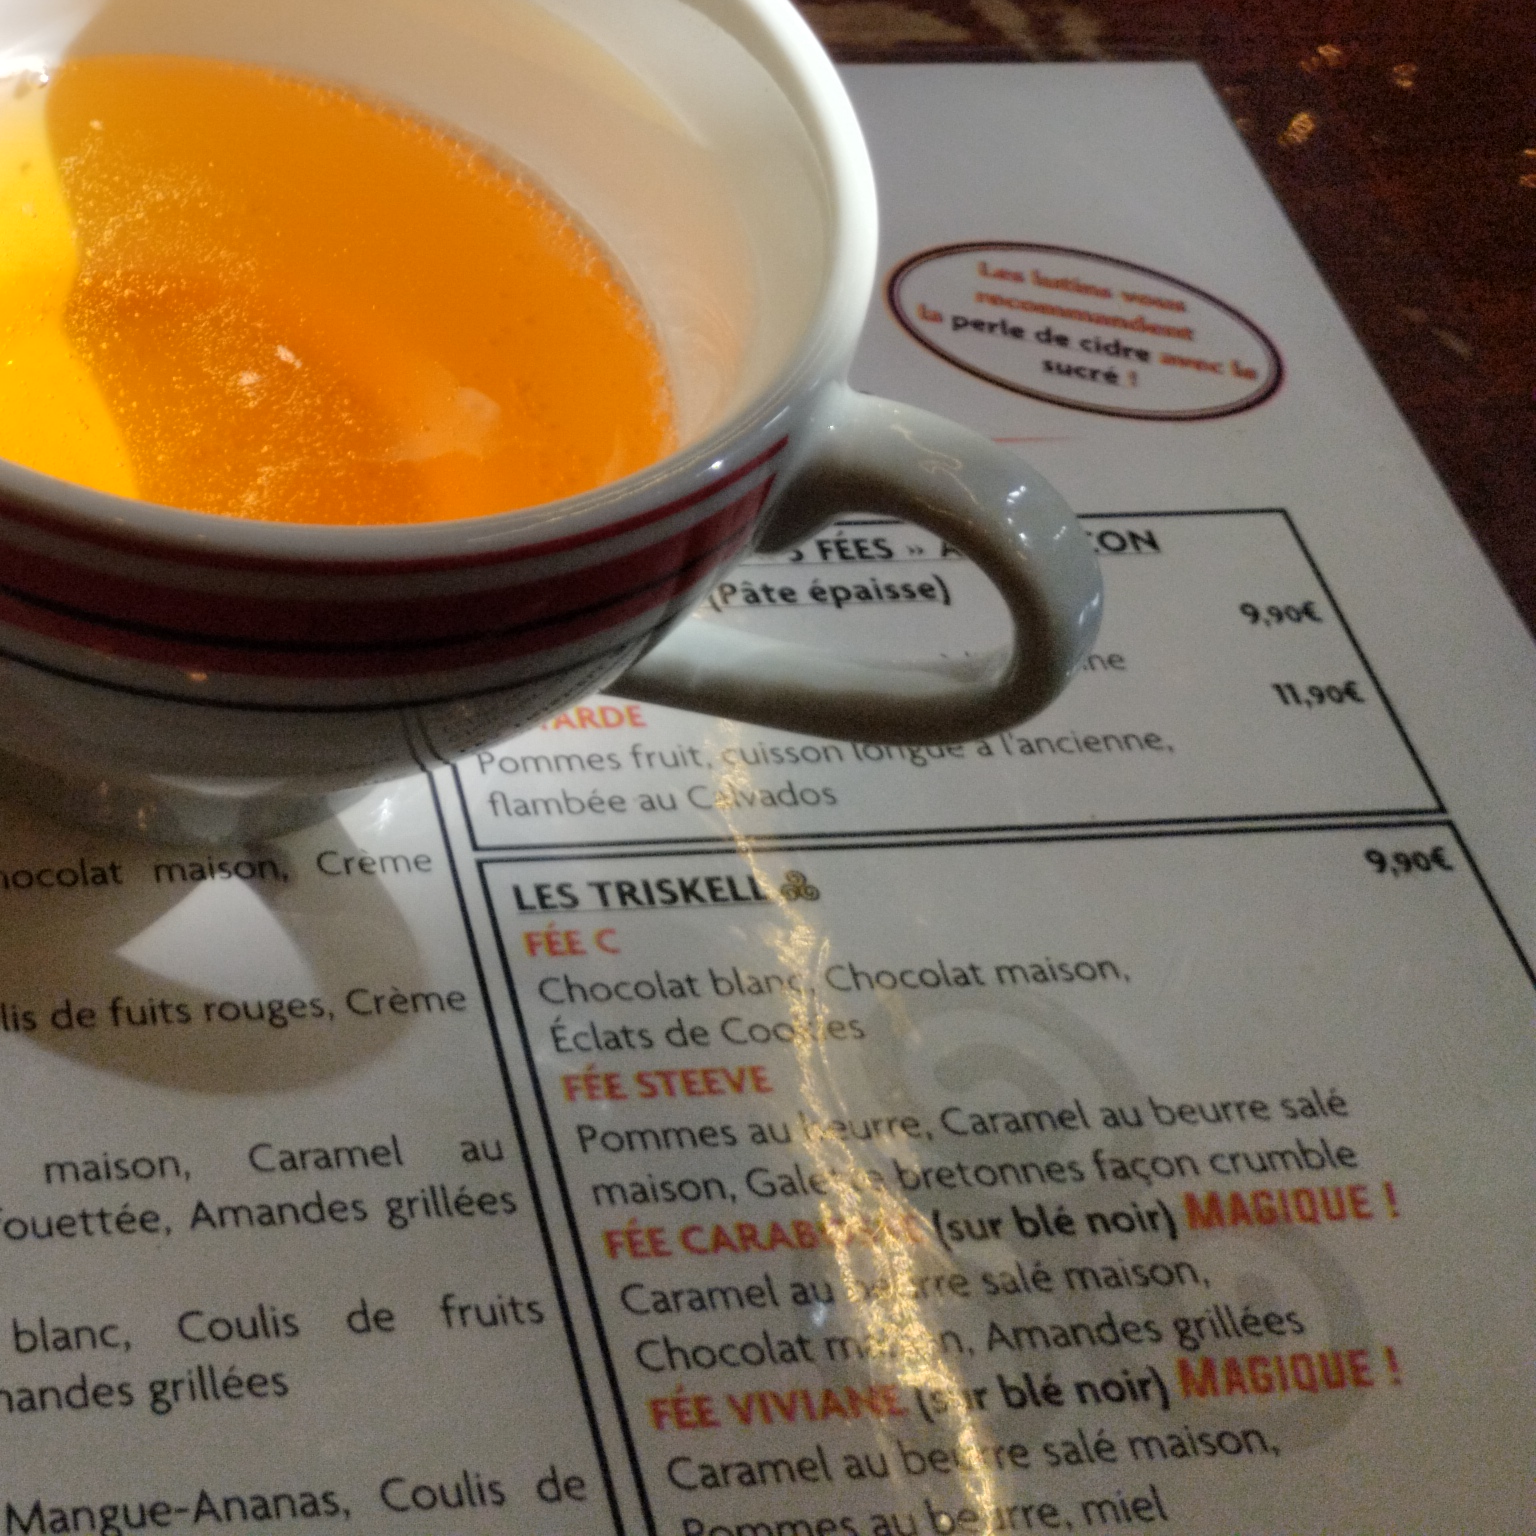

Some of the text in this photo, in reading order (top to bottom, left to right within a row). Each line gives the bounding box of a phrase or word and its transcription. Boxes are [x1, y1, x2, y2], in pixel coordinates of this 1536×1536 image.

[977, 261, 1024, 283] Les
[951, 313, 1025, 341] perle
[1034, 324, 1069, 349] de
[1079, 334, 1151, 363] cidre
[1041, 357, 1120, 386] sucré
[818, 531, 894, 562] FÉES
[709, 574, 953, 613] (Pâte épaisse)
[1240, 601, 1322, 627] 9,90€
[1273, 681, 1365, 707] 11,90€
[1001, 730, 1174, 756] l'ancienne,
[488, 788, 626, 817] flambée
[1365, 846, 1454, 877] 9,90€
[512, 882, 580, 911] LES
[594, 928, 622, 954] C
[538, 956, 1131, 1005] Chocolat Chocolat maison,
[345, 986, 468, 1017] Crème
[665, 1017, 710, 1047] de
[634, 1065, 774, 1098] STEEVE
[577, 1086, 1350, 1154] Pommes au Caramel au beurre salé
[45, 1152, 191, 1184] maison,
[248, 1134, 404, 1173] Caramel
[592, 1137, 1360, 1207] maison, bretonnes façon crumble
[190, 1189, 368, 1231] Amandes
[1011, 1182, 1374, 1240] blé MAGIQUE
[620, 1272, 780, 1316] Caramel
[790, 1280, 835, 1305] au
[981, 1261, 1054, 1294] salé
[1065, 1258, 1211, 1290] maison,
[12, 1316, 132, 1355] blanc,
[177, 1303, 300, 1344] Coulis
[635, 1330, 813, 1373] Chocolat
[986, 1310, 1162, 1353] Amandes
[1172, 1305, 1307, 1351] grillées
[727, 1348, 1375, 1426] VIVIANE blé MAGIQUE
[667, 1425, 1281, 1491] Caramel au salé maison,
[6, 1488, 351, 1536] Mangue-Ananas,
[380, 1470, 506, 1513] Coulis
[536, 1464, 588, 1503] de
[1080, 1483, 1170, 1525] miel
